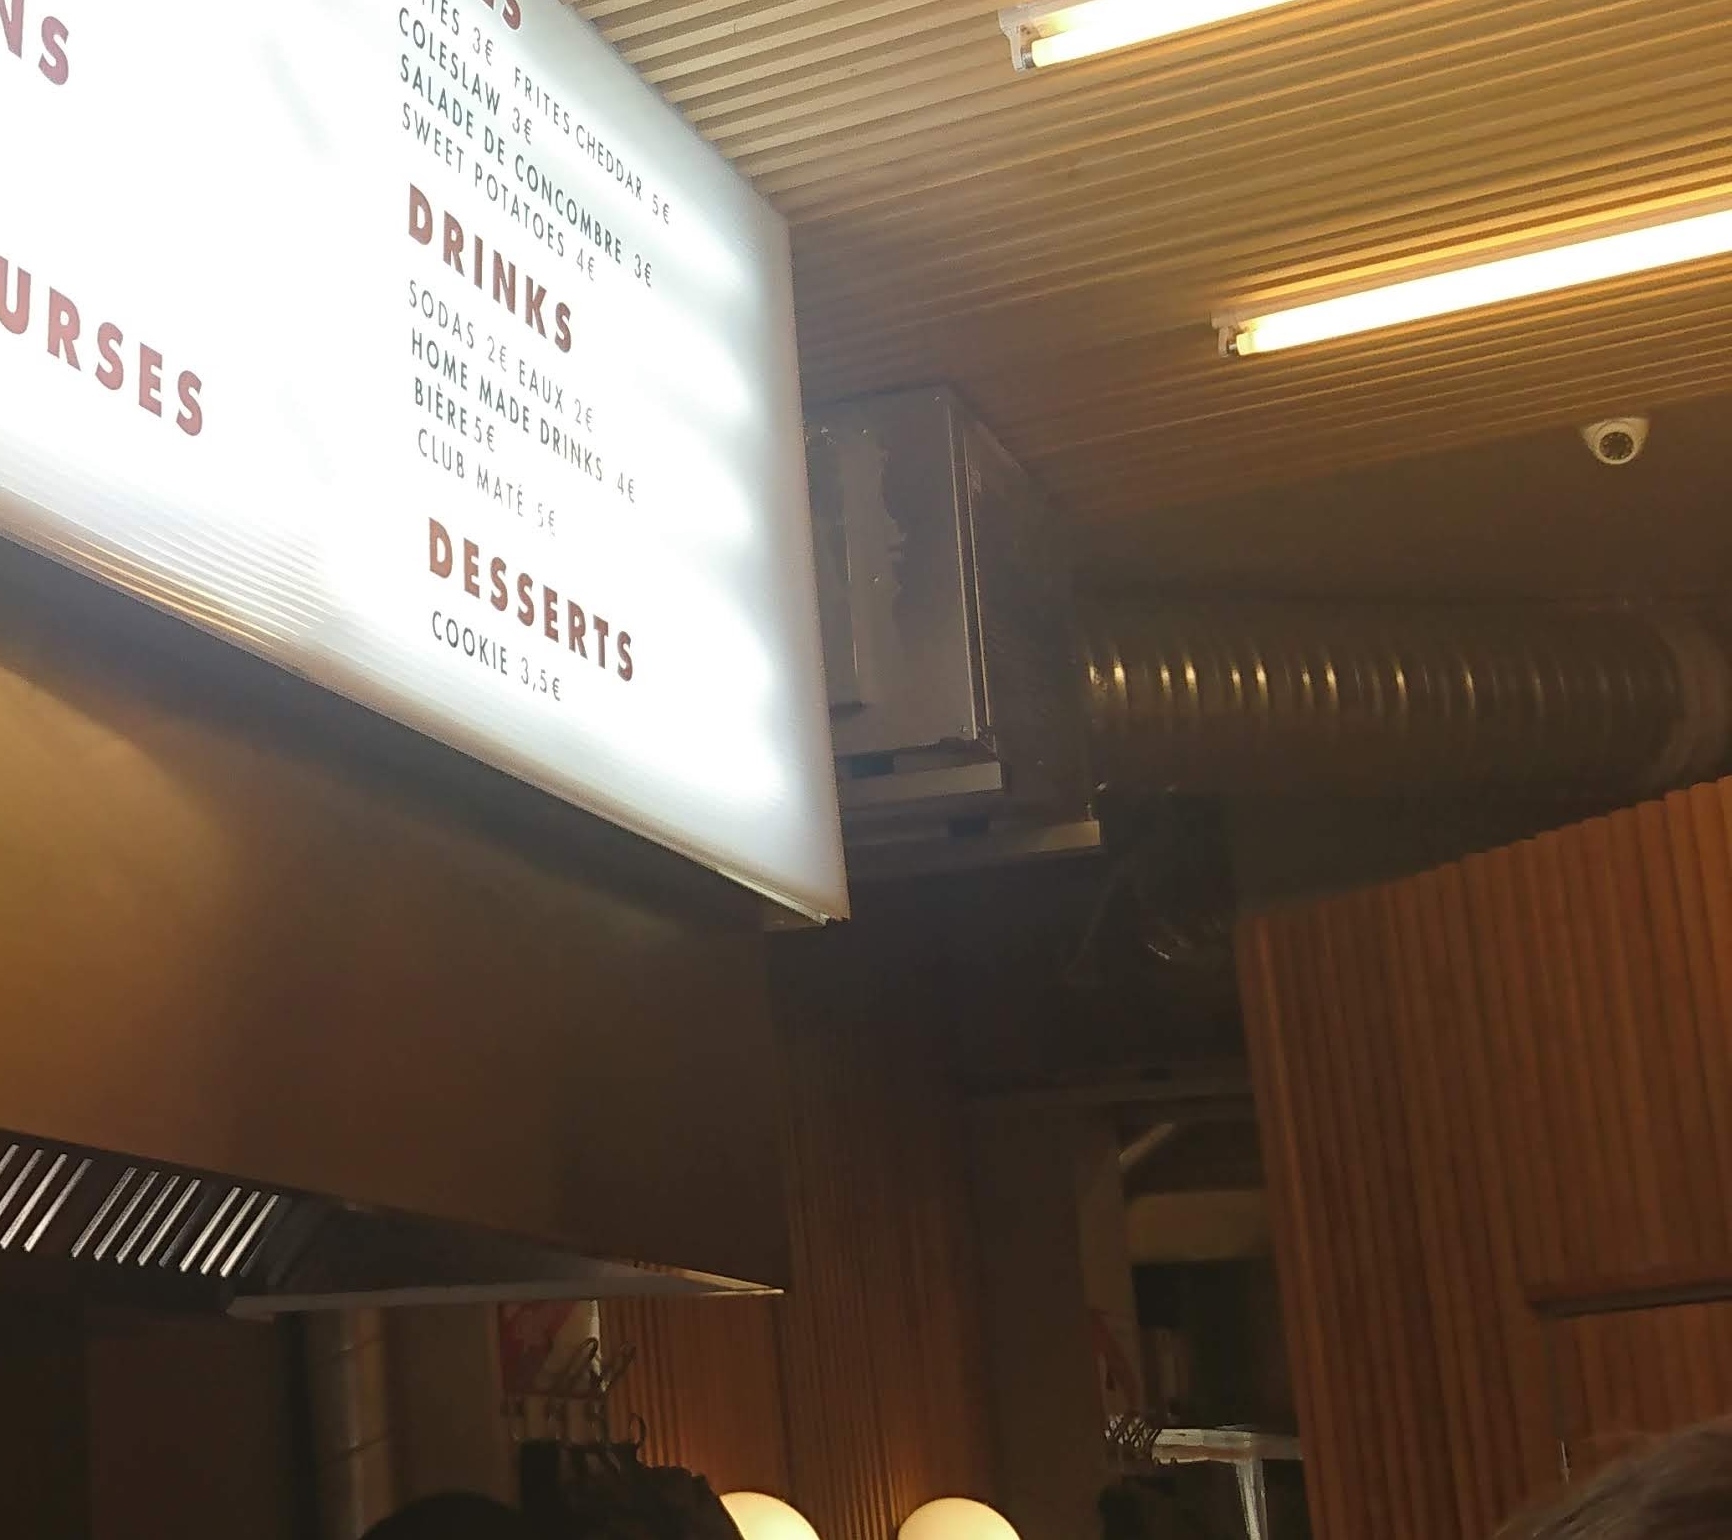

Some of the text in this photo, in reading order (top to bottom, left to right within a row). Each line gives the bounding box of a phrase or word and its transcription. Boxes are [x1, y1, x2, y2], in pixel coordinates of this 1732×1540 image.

[399, 7, 532, 146] COLESLAW 3€
[472, 28, 494, 66] 3€
[514, 67, 571, 135] FRITES
[576, 125, 642, 200] CHEDDAR
[653, 197, 671, 225] 5€
[400, 54, 653, 287] SALADE DE CONCOMBRE 3€
[402, 104, 595, 281] SWEET POTATOES 4€
[408, 182, 571, 353] DRINKS
[409, 280, 592, 433] SODAS 2€ EAUX 2€
[412, 327, 635, 503] HOME MADE DRINKS 4€
[415, 377, 495, 452] BIÈRE 5€
[418, 428, 465, 479] CLUB
[477, 464, 523, 517] MATÉ
[428, 517, 634, 682] DESSERTS
[432, 611, 561, 701] COOKIE 3,5€
